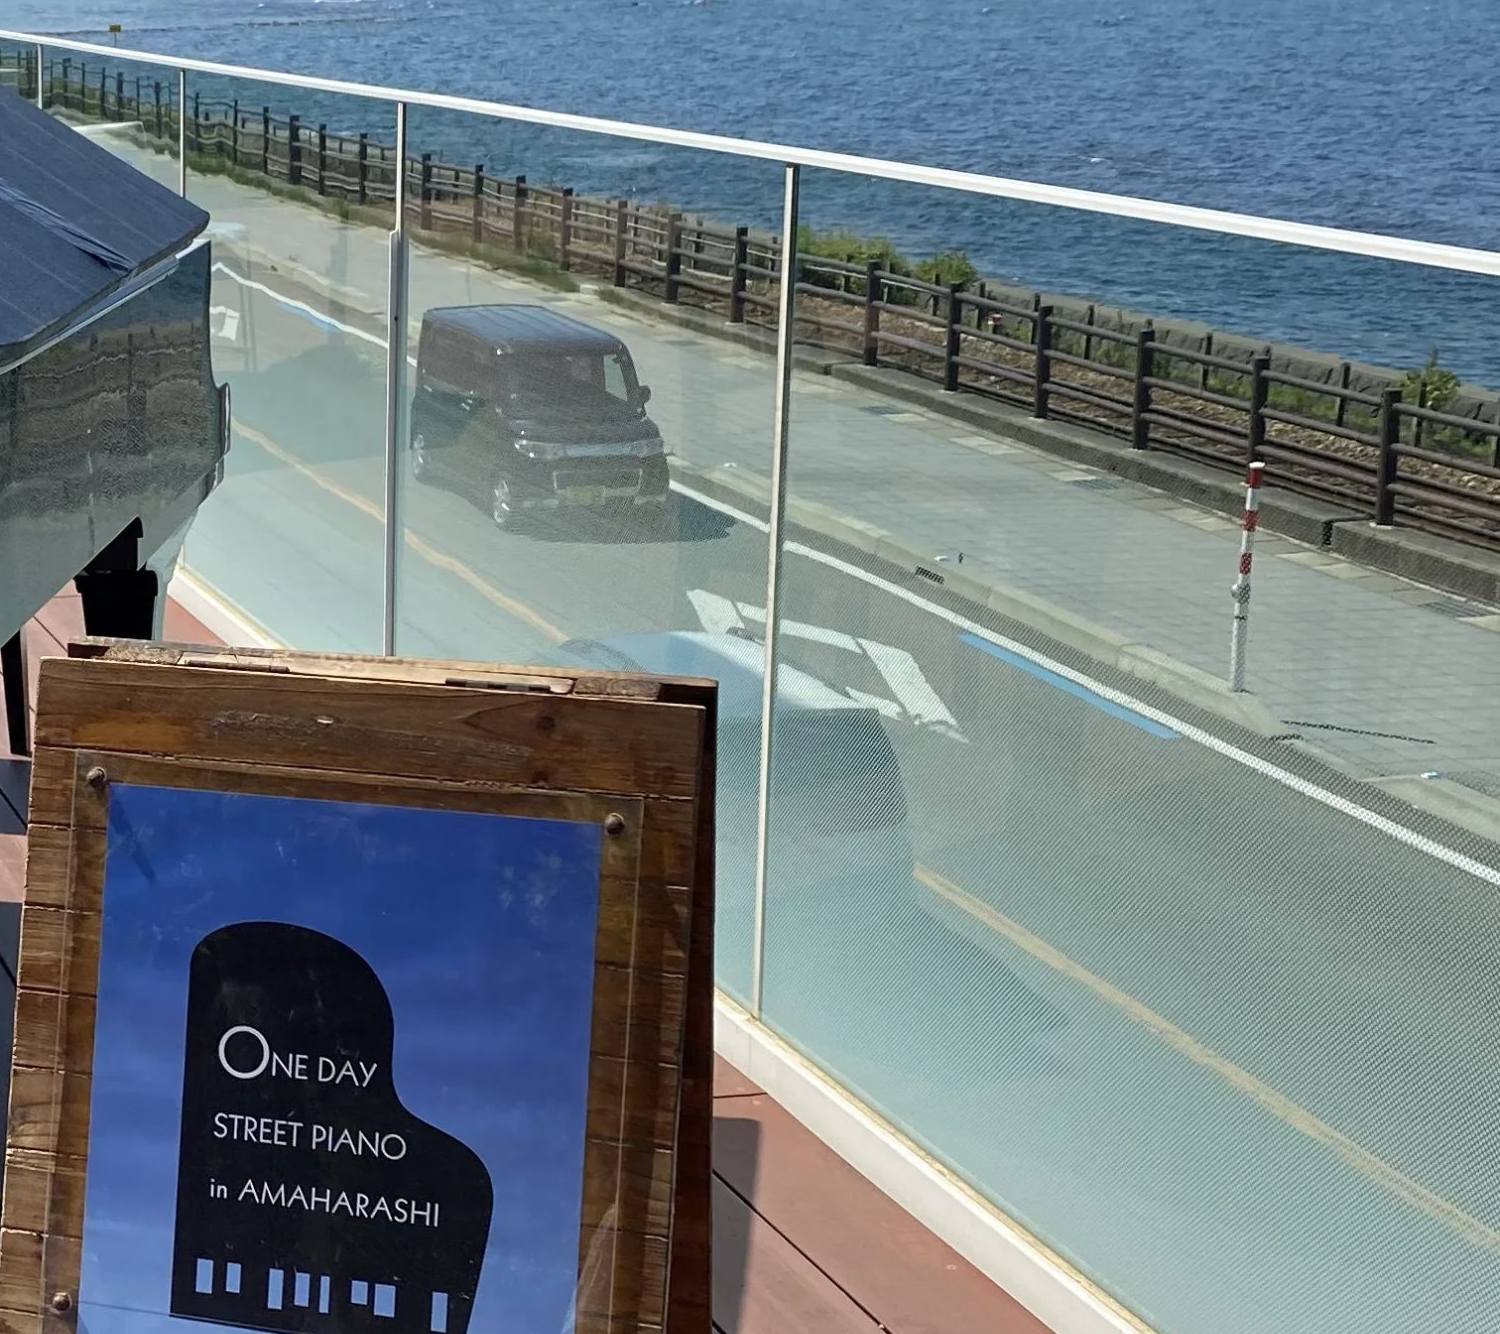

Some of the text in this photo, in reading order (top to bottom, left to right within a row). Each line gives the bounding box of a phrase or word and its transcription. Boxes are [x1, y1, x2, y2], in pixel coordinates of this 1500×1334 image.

[218, 1025, 378, 1088] ONE DAY
[213, 1112, 407, 1160] STREET PIANO
[210, 1178, 440, 1228] in AMAHARASHI
